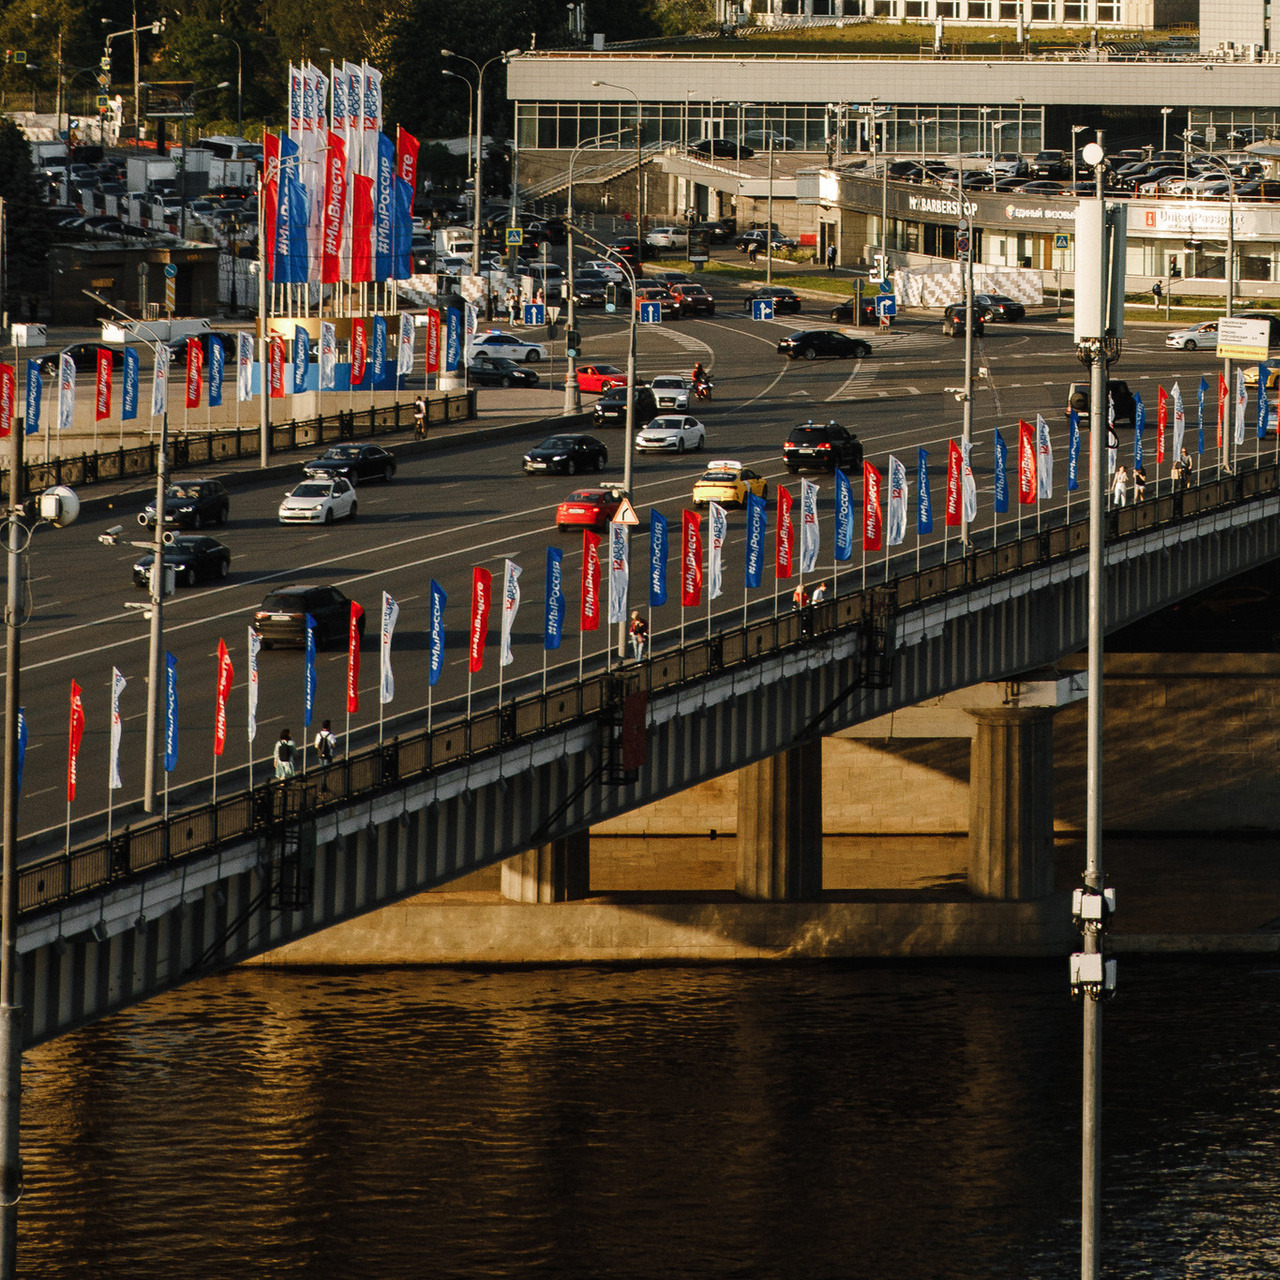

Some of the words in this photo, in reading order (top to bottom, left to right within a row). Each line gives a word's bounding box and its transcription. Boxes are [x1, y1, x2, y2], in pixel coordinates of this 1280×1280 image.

[377, 156, 390, 255] #МыРоссия
[1015, 207, 1043, 219] ЕДИНЫЙ
[1044, 209, 1076, 220] ВИЗОВЫ
[652, 522, 664, 594] #МыРоссия
[748, 505, 761, 575] #МыРоссия
[547, 560, 561, 636] #МыРоссия
